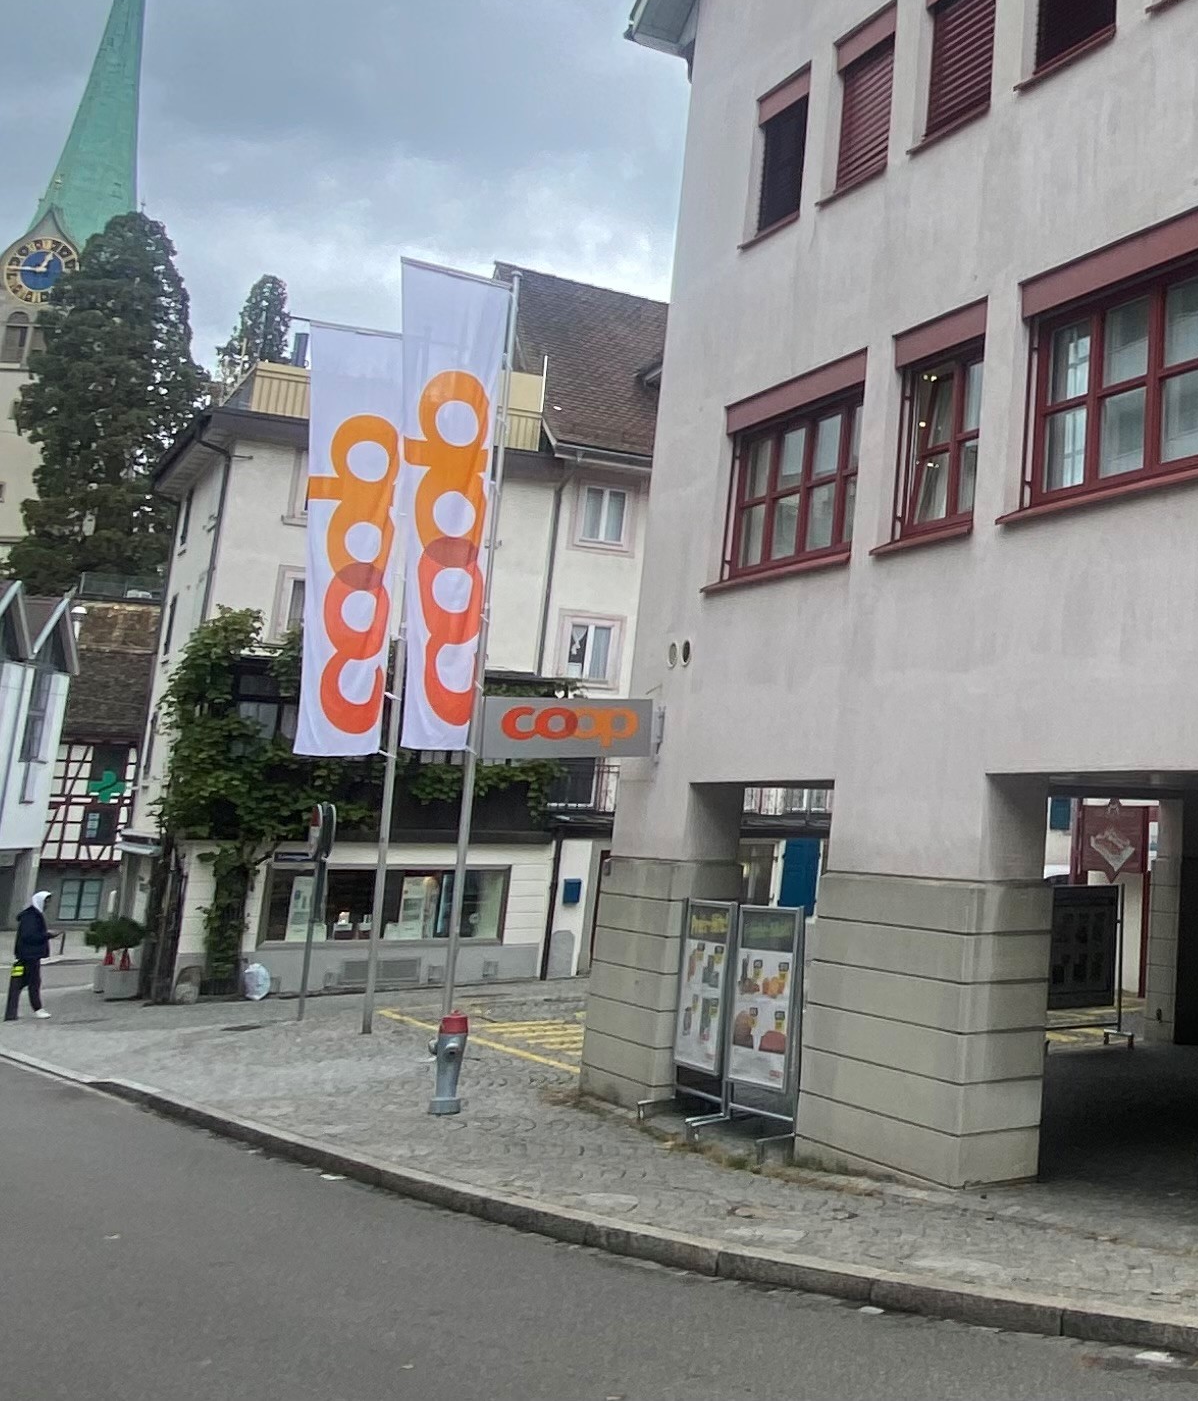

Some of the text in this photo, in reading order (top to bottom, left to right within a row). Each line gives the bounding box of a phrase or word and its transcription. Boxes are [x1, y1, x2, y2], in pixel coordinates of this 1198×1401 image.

[307, 413, 400, 734] coop
[403, 370, 490, 726] coop
[502, 706, 640, 748] coop
